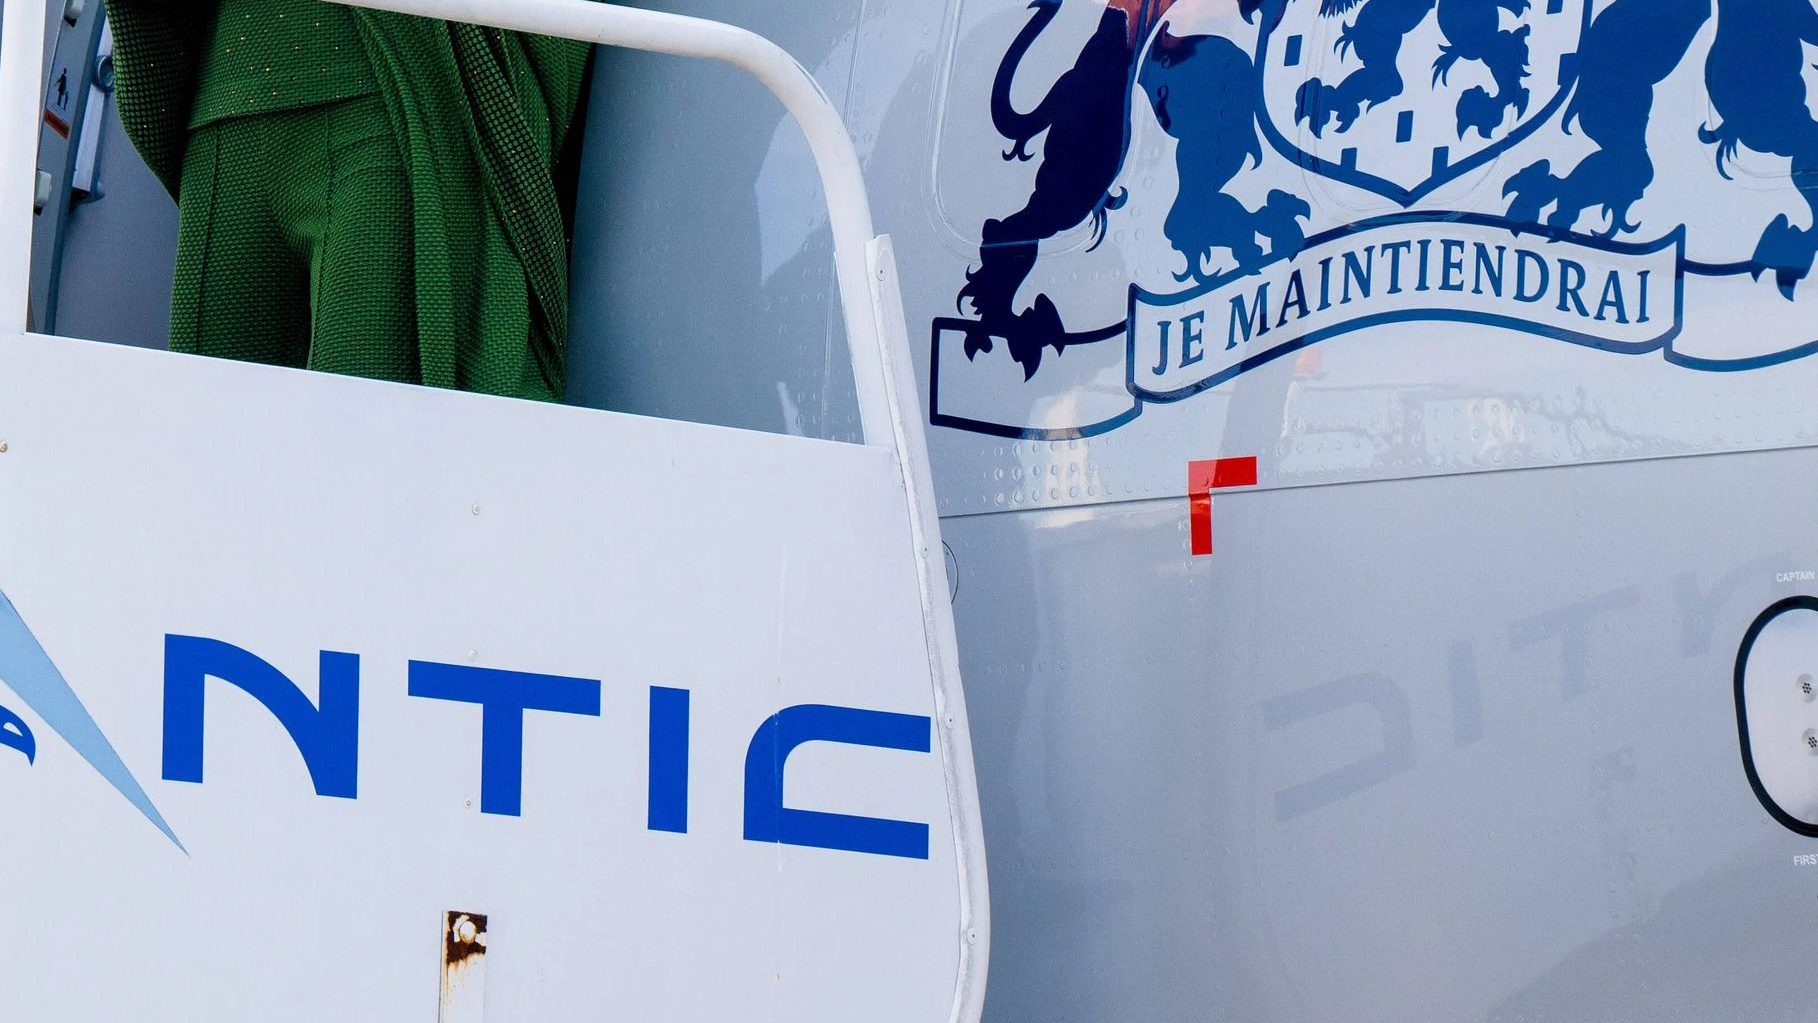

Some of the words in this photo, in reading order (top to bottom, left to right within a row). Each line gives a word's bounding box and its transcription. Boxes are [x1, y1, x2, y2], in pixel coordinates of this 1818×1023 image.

[1152, 309, 1205, 375] JE
[1225, 238, 1651, 351] MAINTIENDRAI
[1776, 570, 1815, 582] CAPTAIN
